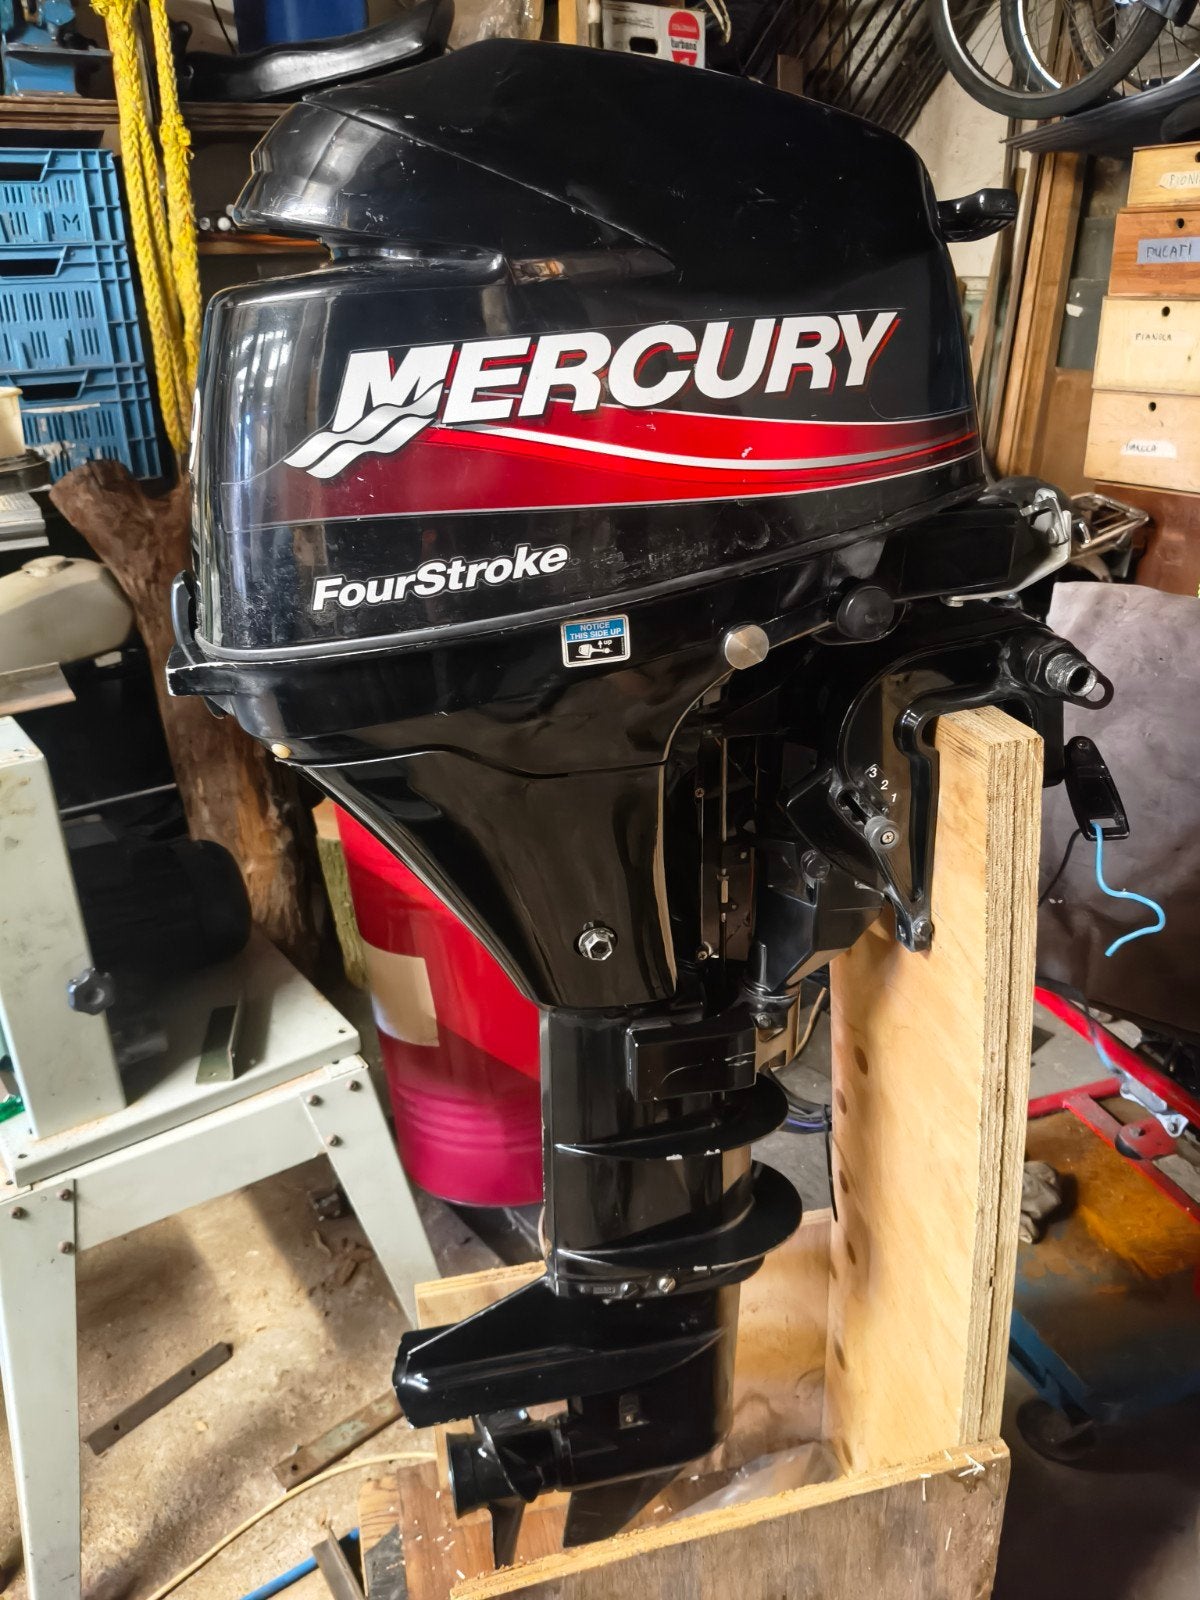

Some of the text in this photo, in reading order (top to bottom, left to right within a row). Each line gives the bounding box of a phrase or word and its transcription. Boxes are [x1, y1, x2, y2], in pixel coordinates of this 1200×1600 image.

[1146, 243, 1193, 258] DUCATI
[332, 311, 898, 432] MERCURY
[312, 545, 568, 611] FourStroke
[580, 621, 611, 631] NOTICE
[569, 627, 622, 640] THIS SIDE UP
[868, 767, 878, 778] 3
[880, 779, 889, 790] 2
[891, 792, 897, 803] 1
